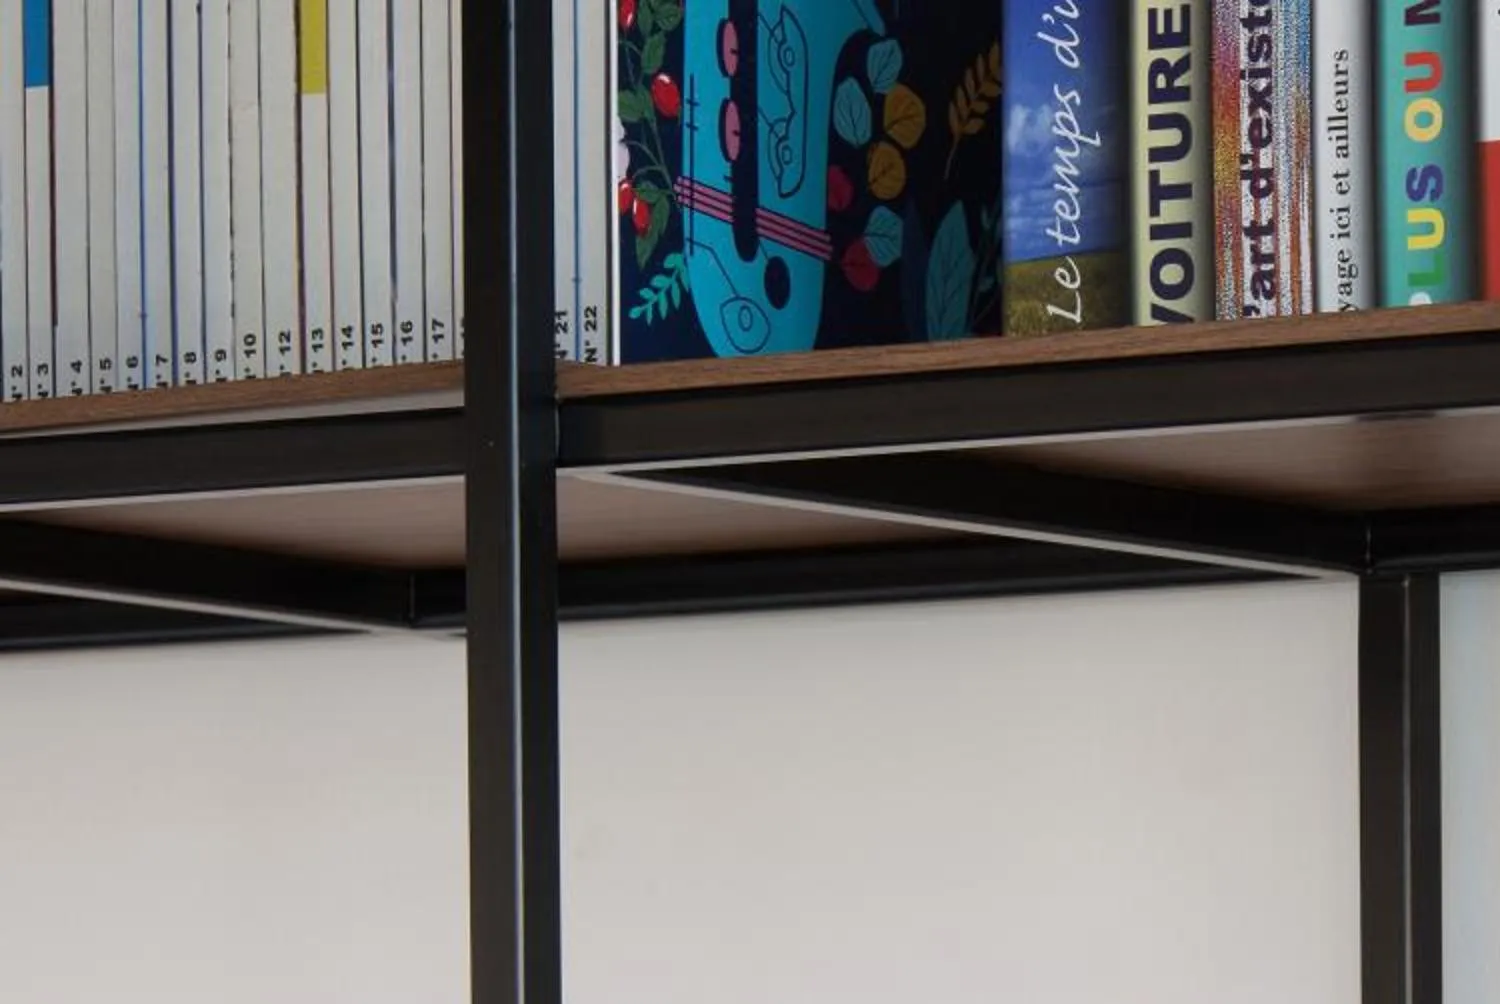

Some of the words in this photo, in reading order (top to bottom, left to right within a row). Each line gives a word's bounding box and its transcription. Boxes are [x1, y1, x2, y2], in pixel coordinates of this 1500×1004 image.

[1240, 0, 1274, 199] d'exist
[1327, 49, 1349, 159] ailleurs
[1404, 51, 1443, 143] OU
[1045, 84, 1101, 247] temps
[1332, 169, 1350, 195] et
[1329, 207, 1350, 240] ici
[1241, 219, 1275, 316] 'art
[1046, 256, 1081, 323] Le
[555, 310, 568, 334] 21
[584, 305, 597, 331] 22
[279, 330, 291, 355] 12
[312, 328, 323, 352] 13
[342, 326, 354, 350] 14
[372, 323, 384, 348] 15
[401, 320, 413, 346] 16
[432, 319, 444, 344] 17
[184, 352, 196, 363] 8
[215, 349, 227, 361] 9
[244, 334, 256, 357] 10
[11, 365, 23, 377] 2
[37, 363, 49, 375] 3
[70, 360, 82, 373] 4
[99, 358, 112, 370] 5
[126, 356, 138, 368] 6
[156, 354, 168, 365] 7
